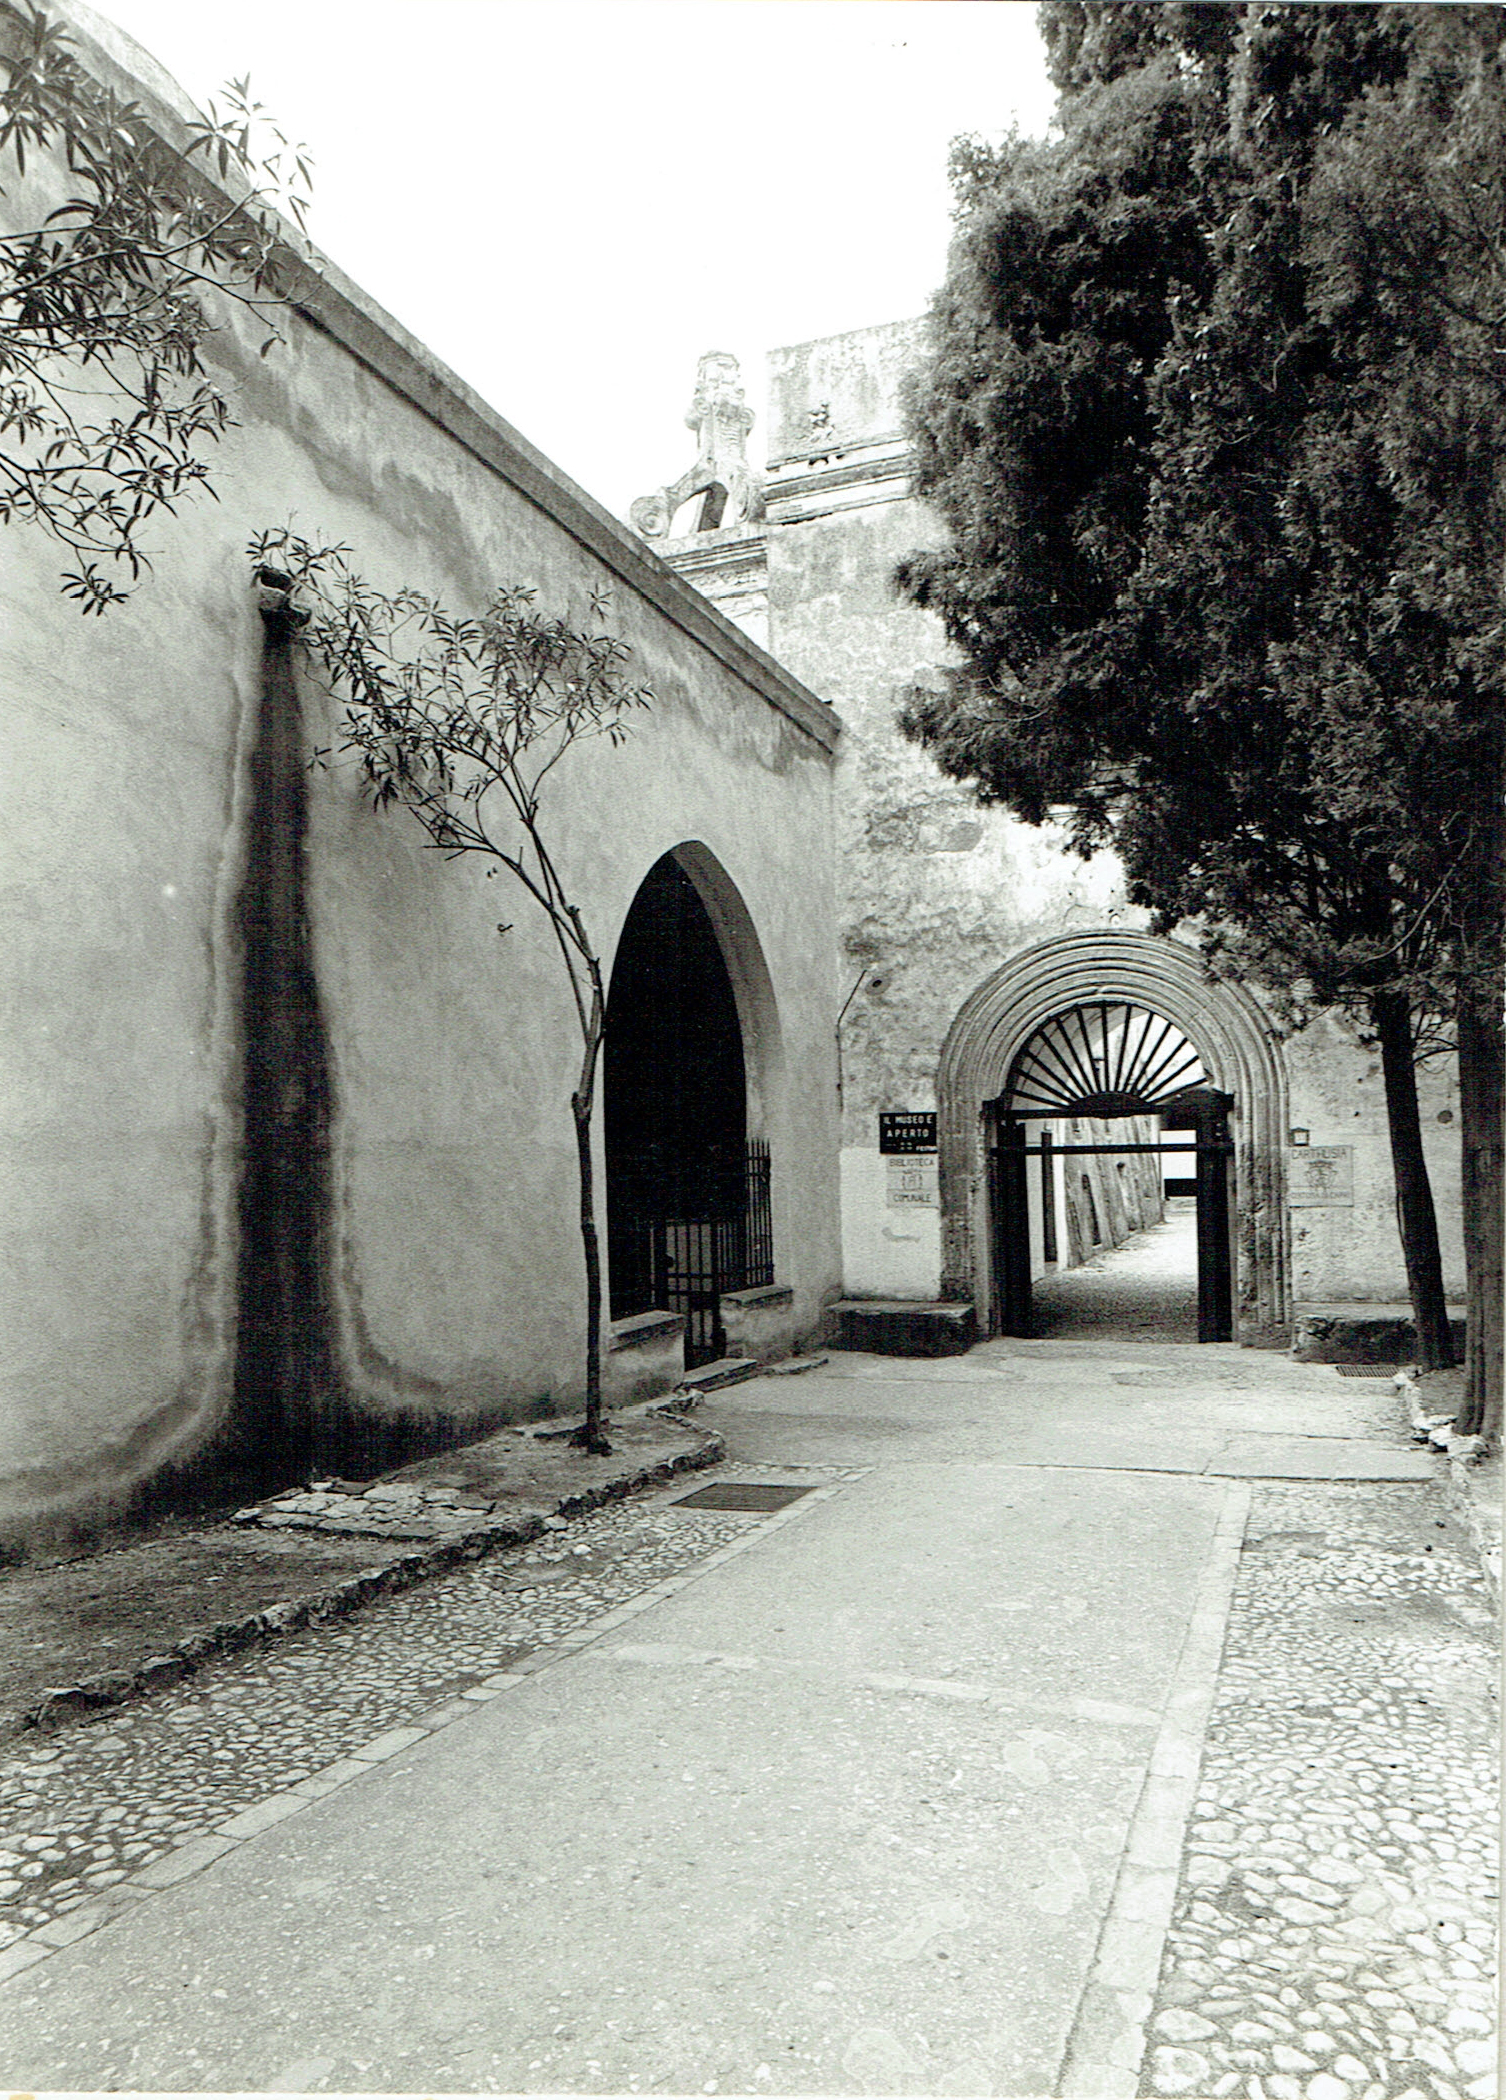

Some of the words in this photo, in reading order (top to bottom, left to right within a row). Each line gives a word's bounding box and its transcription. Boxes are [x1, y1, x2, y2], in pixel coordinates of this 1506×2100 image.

[895, 1115, 925, 1124] MUSEO
[886, 1128, 930, 1138] APERTO
[1291, 1148, 1347, 1160] CARTHUSIA
[889, 1158, 935, 1167] BIBLIOTECA
[893, 1193, 932, 1203] COMUNALE
